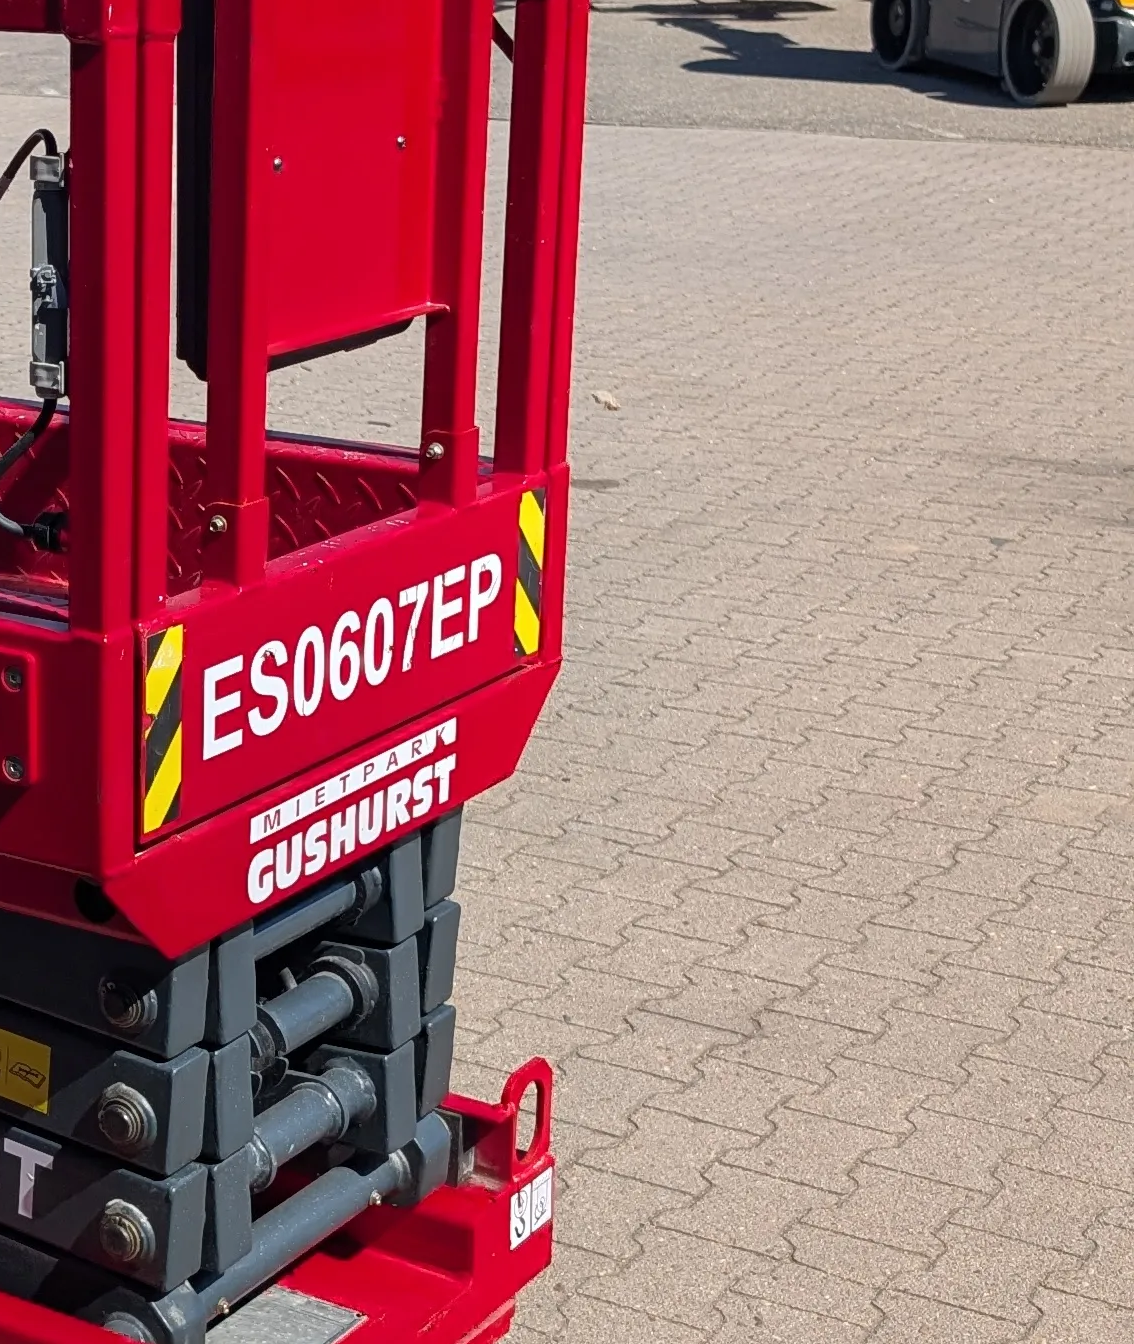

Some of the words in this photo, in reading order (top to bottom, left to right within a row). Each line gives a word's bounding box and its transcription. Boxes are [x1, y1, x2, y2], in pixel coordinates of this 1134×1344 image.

[202, 553, 502, 761] ES0607EP
[247, 753, 457, 905] GUSHURST
[263, 726, 447, 834] MIETPARK
